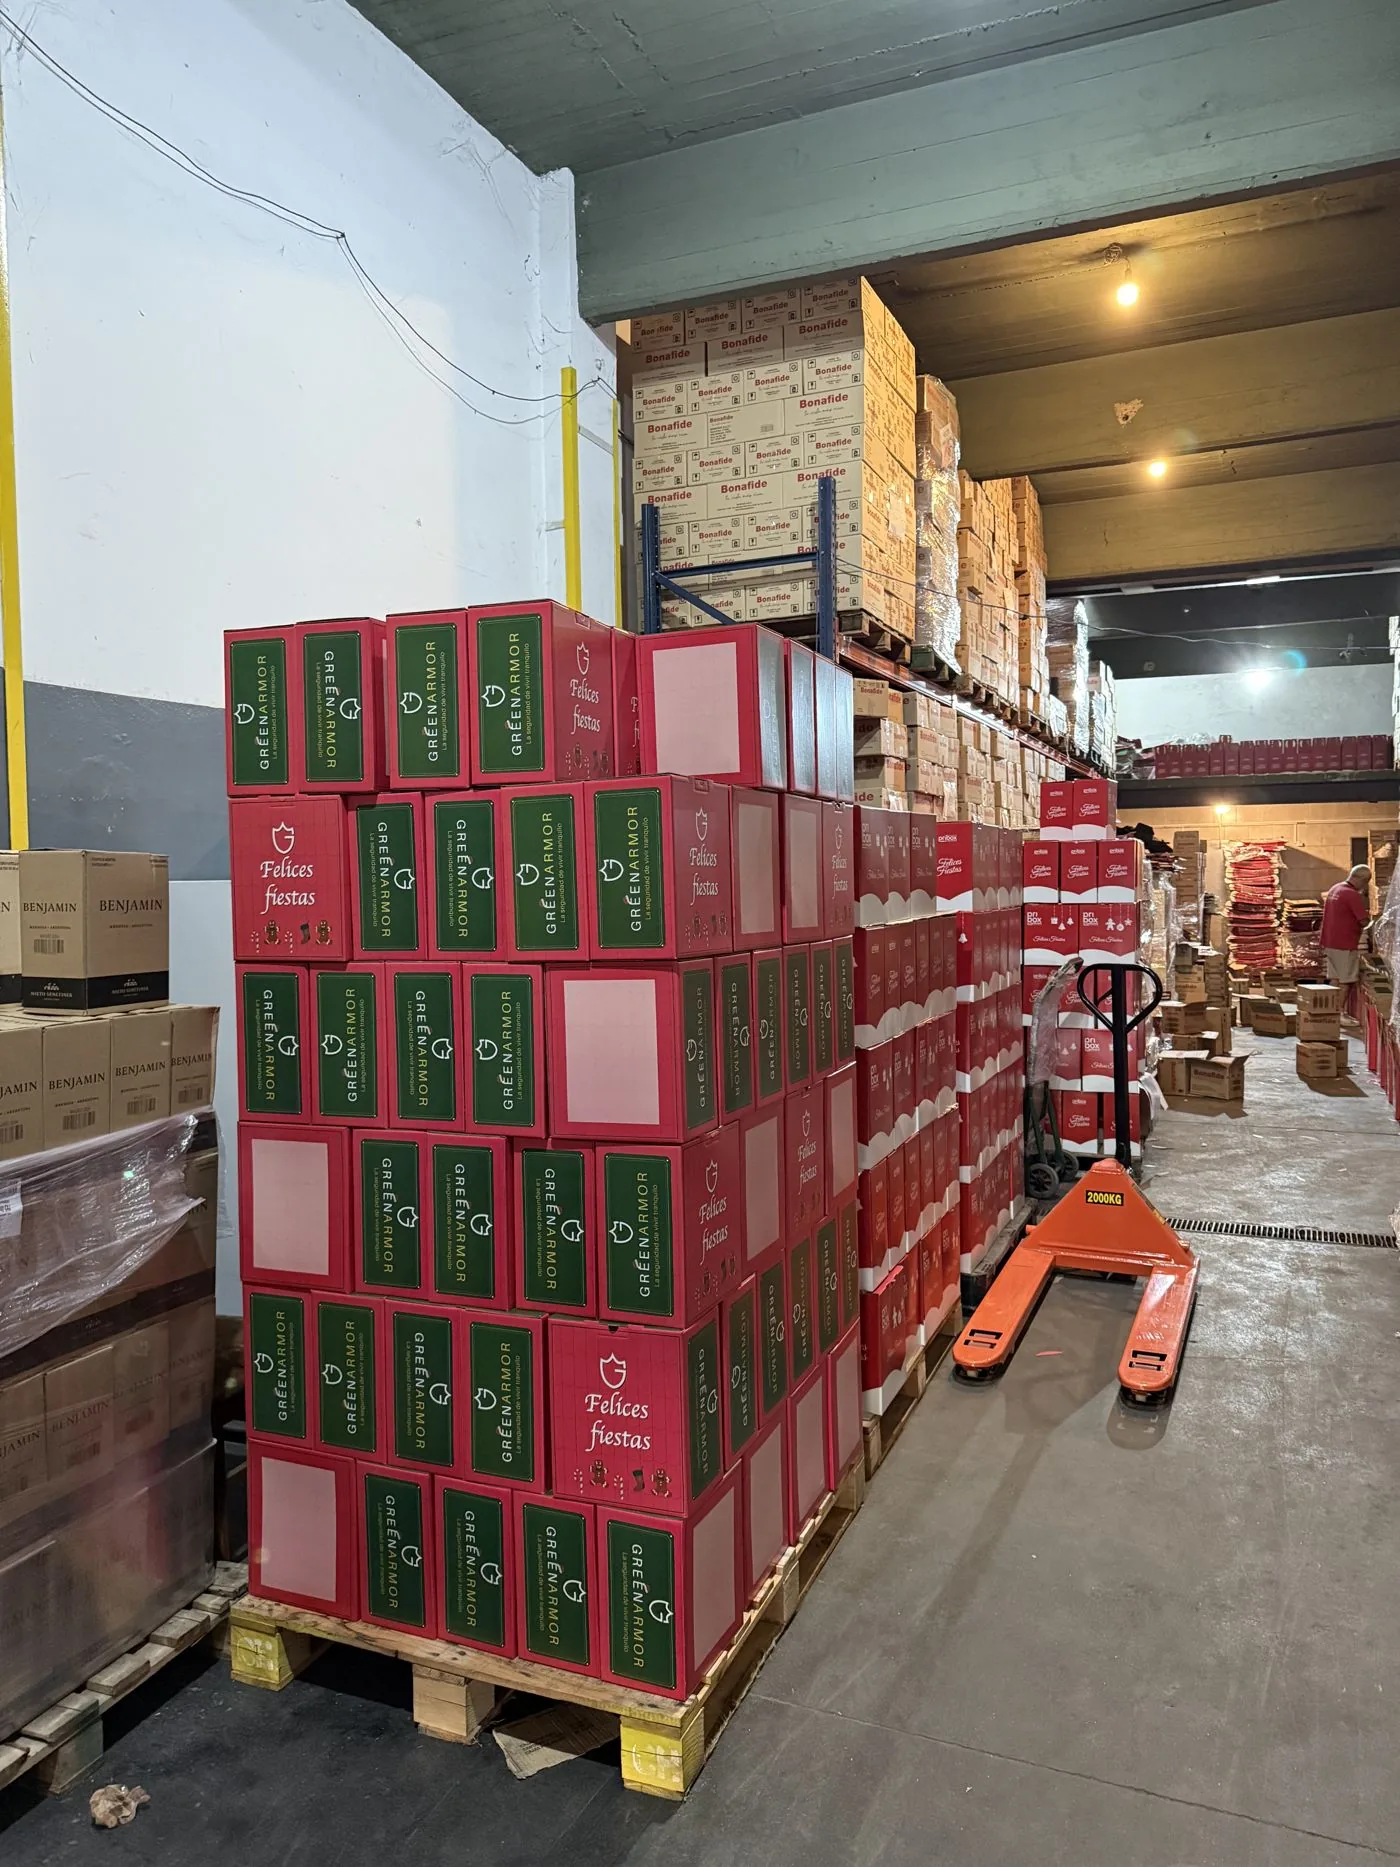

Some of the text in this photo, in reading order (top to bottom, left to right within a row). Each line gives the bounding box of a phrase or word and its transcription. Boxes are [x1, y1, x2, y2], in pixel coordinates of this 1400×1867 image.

[753, 302, 788, 314] Bonafide
[800, 318, 848, 334] Bonafide
[721, 333, 768, 350] Bonafide
[646, 350, 690, 364] Bonafide
[815, 364, 852, 376] Bonafide
[754, 374, 790, 386] Bonafide
[698, 386, 732, 396] Bonafide
[642, 396, 676, 406] Bonafide
[800, 393, 848, 408] Bonafide
[648, 420, 692, 433] Bonafide
[816, 438, 852, 450] Bonafide
[756, 448, 792, 460] Bonafide
[700, 456, 733, 468] Bonafide
[642, 466, 674, 476] Bonafide
[797, 468, 846, 482] Bonafide
[720, 480, 768, 494] Bonafide
[648, 490, 692, 504] Bonafide
[698, 529, 732, 540] Bonafide
[756, 594, 791, 603] Bonafide
[570, 678, 599, 704] Felices
[571, 704, 600, 735] fiestas
[938, 834, 957, 842] pribox
[689, 844, 717, 868] Felices
[938, 857, 962, 868] Felices
[260, 855, 314, 879] Felices
[936, 866, 962, 876] Fiestas
[690, 873, 718, 906] fiestas
[260, 884, 316, 914] fiestas
[24, 902, 77, 914] BENJAMIN
[99, 899, 163, 915] BENJAMIN
[116, 1061, 166, 1077] BENJAMIN
[49, 1072, 106, 1090] BENJAMIN
[0, 1081, 38, 1100] JAMIN
[1087, 1192, 1122, 1204] 2000KG
[699, 1194, 727, 1225] Felices
[700, 1225, 728, 1265] fiestas
[584, 1392, 649, 1419] Felices
[584, 1420, 650, 1452] fiestas
